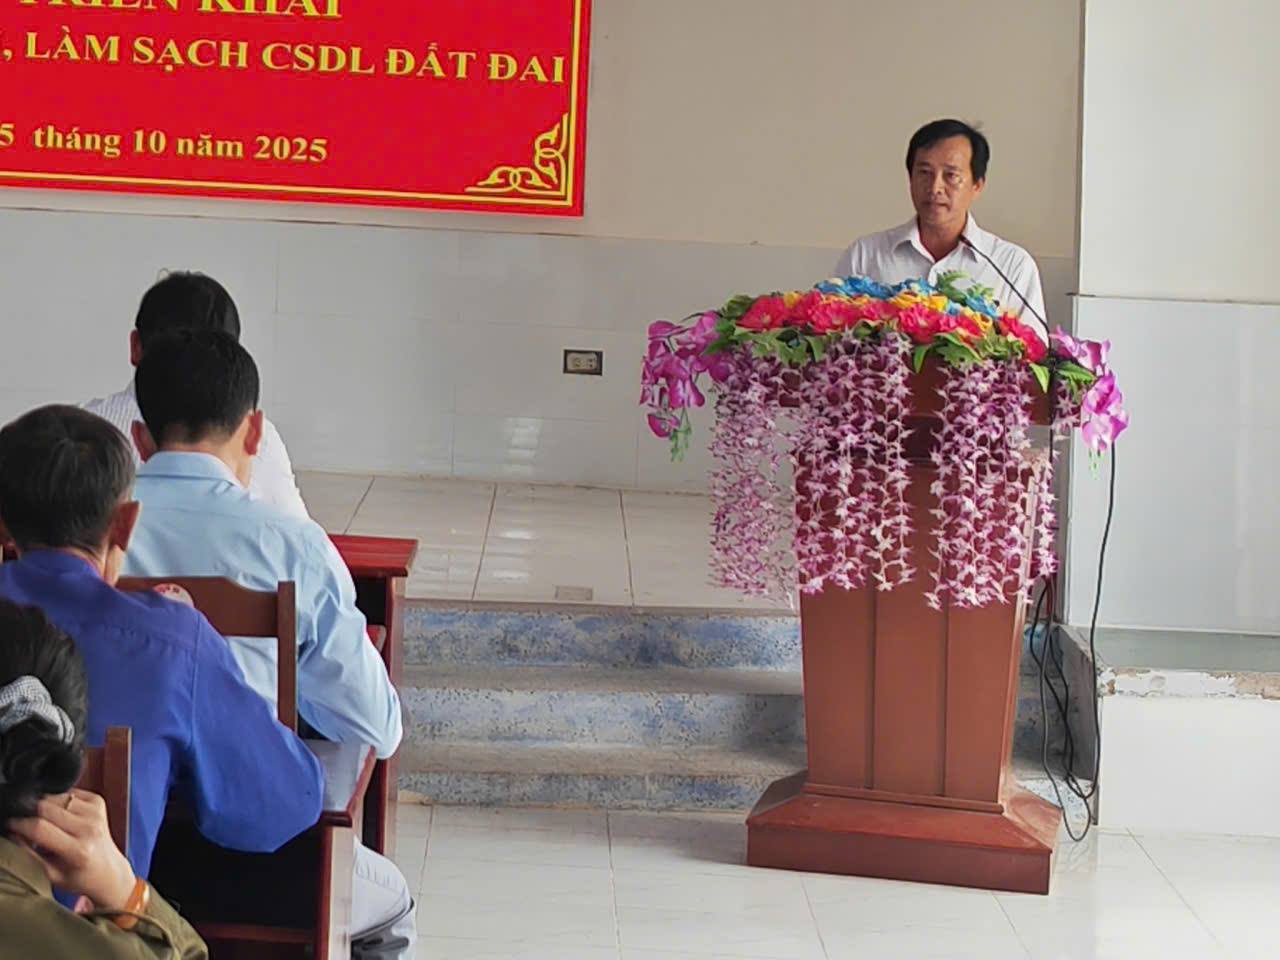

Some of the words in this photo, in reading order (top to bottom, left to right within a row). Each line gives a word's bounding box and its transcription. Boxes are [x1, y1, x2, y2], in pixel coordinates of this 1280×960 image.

[24, 25, 120, 63] LÀM
[133, 33, 249, 73] SẠCH
[261, 39, 375, 76] CSDL
[385, 42, 477, 79] ĐẤT
[487, 51, 566, 83] ĐAI
[33, 125, 121, 159] tháng
[134, 129, 167, 156] 10
[177, 134, 245, 159] năm
[254, 136, 329, 163] 2025
